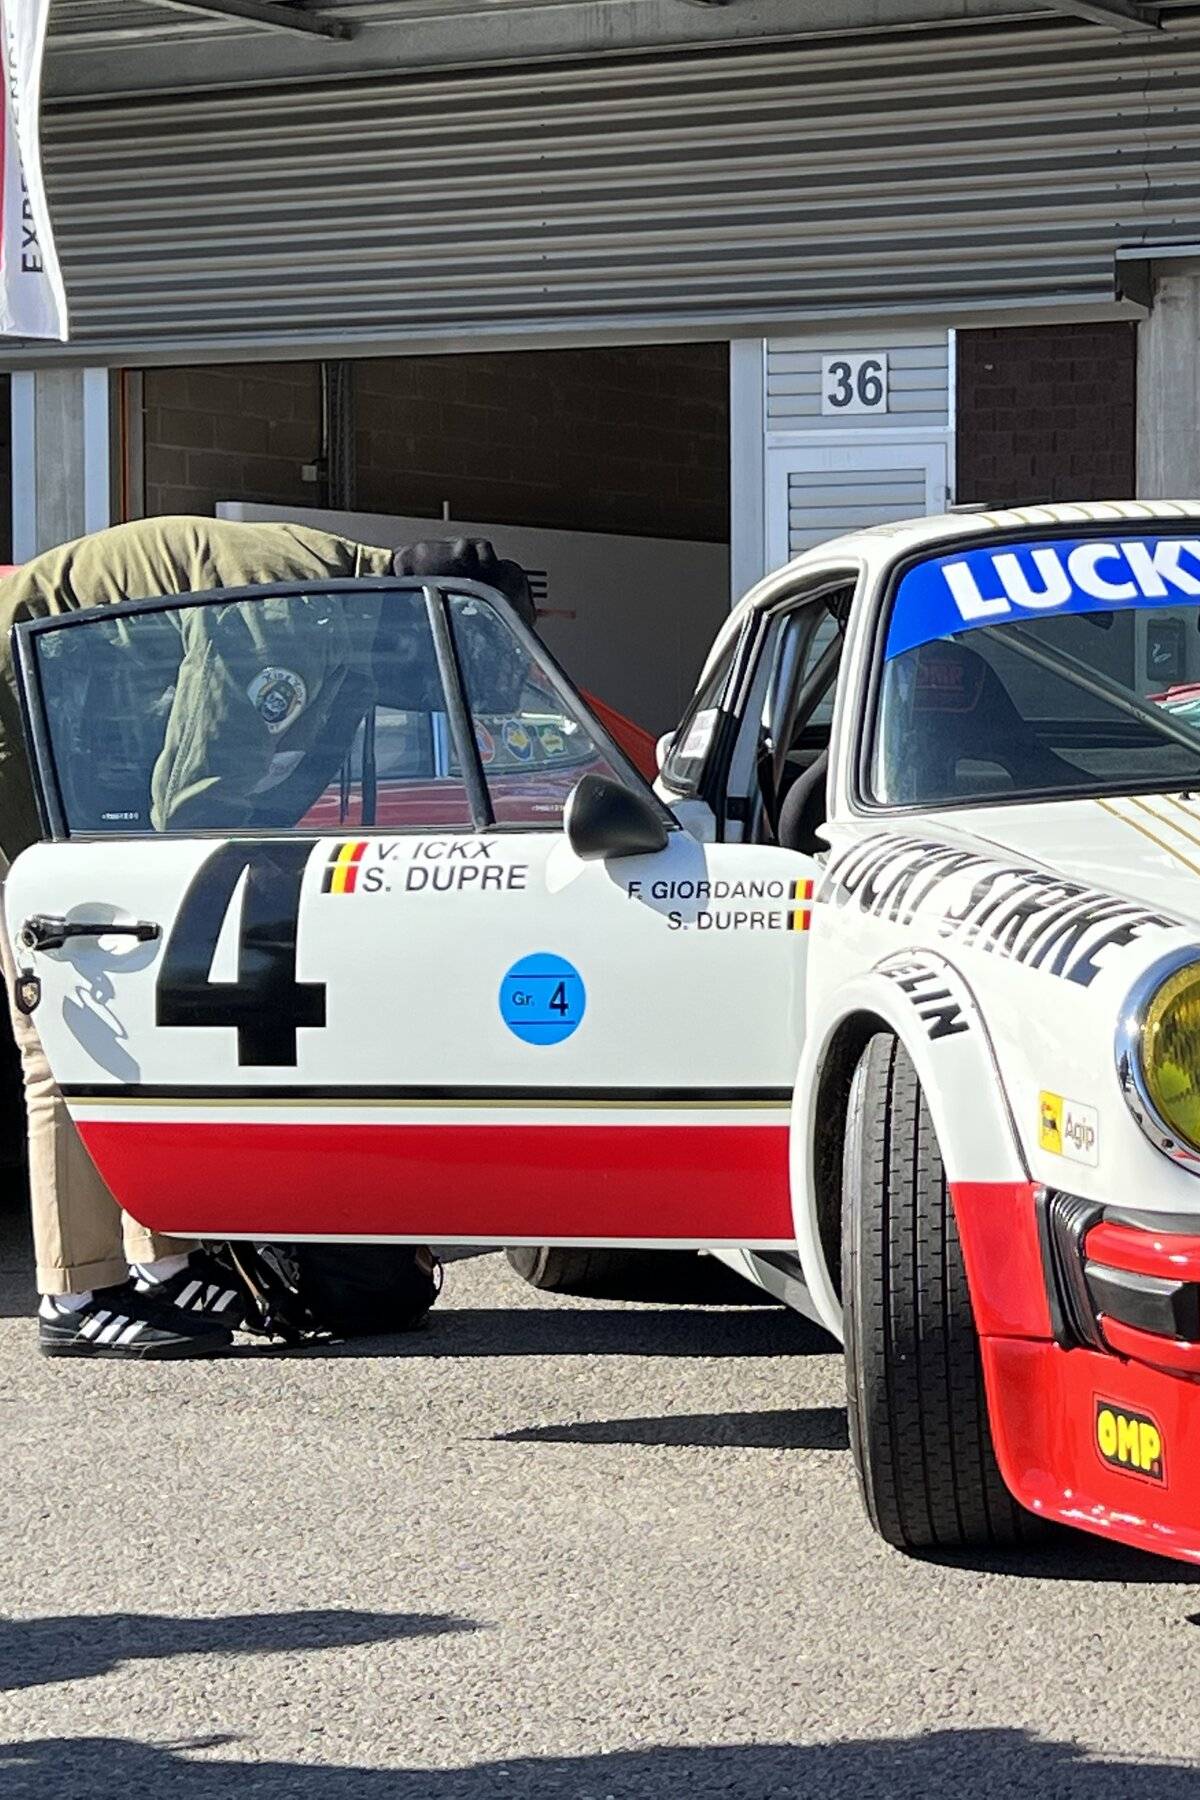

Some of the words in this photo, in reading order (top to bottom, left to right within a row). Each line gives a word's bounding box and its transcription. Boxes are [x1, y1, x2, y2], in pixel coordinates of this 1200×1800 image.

[828, 360, 883, 408] 36
[376, 841, 400, 861] V.
[412, 841, 498, 859] ICKX
[362, 867, 391, 892] S.
[405, 865, 529, 892] DUPRE
[628, 881, 643, 900] F.
[651, 881, 784, 899] GIORDANO
[667, 911, 689, 930] S.
[697, 911, 782, 930] DUPRE
[815, 832, 1000, 926] LUCKY
[937, 867, 1185, 988] STRIKE
[156, 840, 327, 1067] 4
[511, 991, 535, 1006] Gr.
[549, 981, 569, 1016] 4
[1064, 1112, 1095, 1152] Agip
[1097, 1409, 1162, 1471] OMP
